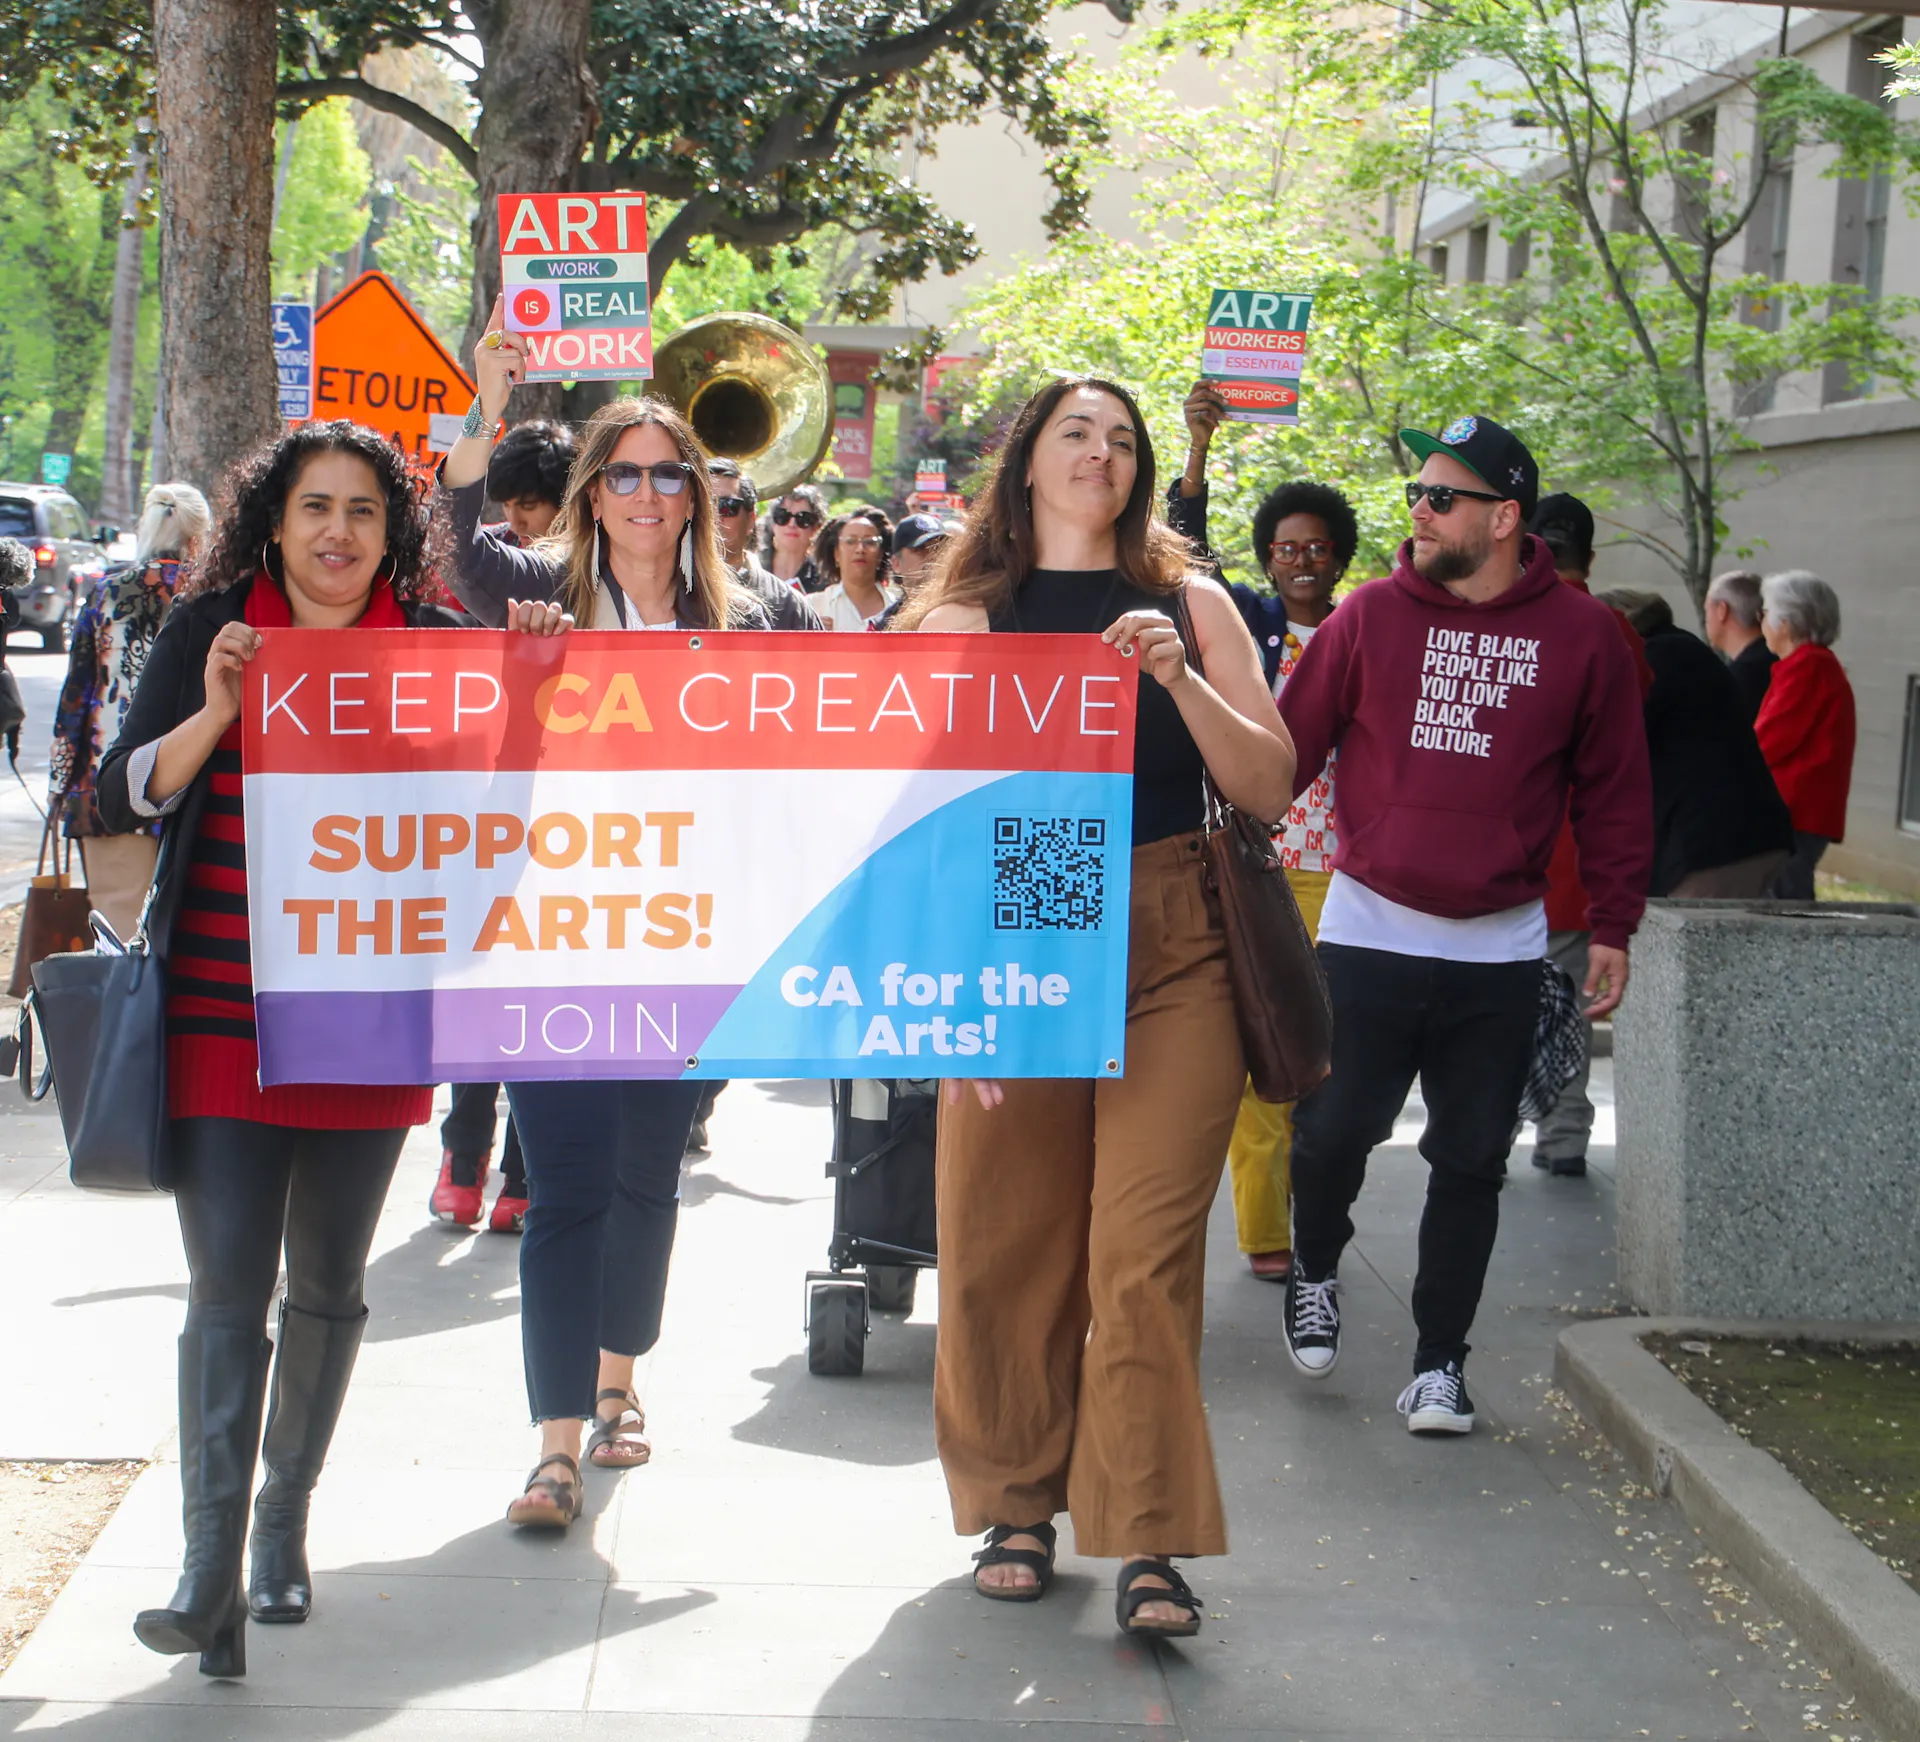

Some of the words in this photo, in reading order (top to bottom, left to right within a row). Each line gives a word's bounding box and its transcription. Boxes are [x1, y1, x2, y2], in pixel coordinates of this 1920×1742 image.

[503, 197, 643, 252] ART
[547, 261, 600, 276] WORK
[524, 300, 540, 315] IS
[564, 291, 646, 318] REAL
[1207, 291, 1313, 331] ART
[273, 349, 309, 367] RKING
[525, 332, 646, 367] WORK
[1209, 331, 1302, 351] WORKERS
[278, 367, 300, 384] NLY
[1225, 356, 1299, 372] ESSENTIAL
[316, 366, 447, 413] ETOUR
[916, 458, 947, 473] ART
[1426, 626, 1474, 654] LOVE
[1477, 634, 1540, 662] BLACK
[1422, 650, 1493, 682] PEOPLE
[1496, 659, 1539, 687] LIKE
[262, 672, 500, 735] KEEP
[534, 673, 654, 734] CA
[679, 673, 1120, 736] CREATIVE
[1420, 673, 1458, 702] YOU
[1461, 681, 1510, 709] LOVE
[1414, 698, 1477, 729] BLACK
[1410, 724, 1493, 758] CULTURE
[308, 811, 695, 873] SUPPORT
[282, 897, 447, 955] THE
[472, 893, 714, 952] ARTS!
[780, 964, 863, 1006] CA
[880, 962, 963, 1006] for
[979, 963, 1070, 1006] the
[499, 1002, 677, 1055] JOIN
[858, 1014, 997, 1056] Arts!
